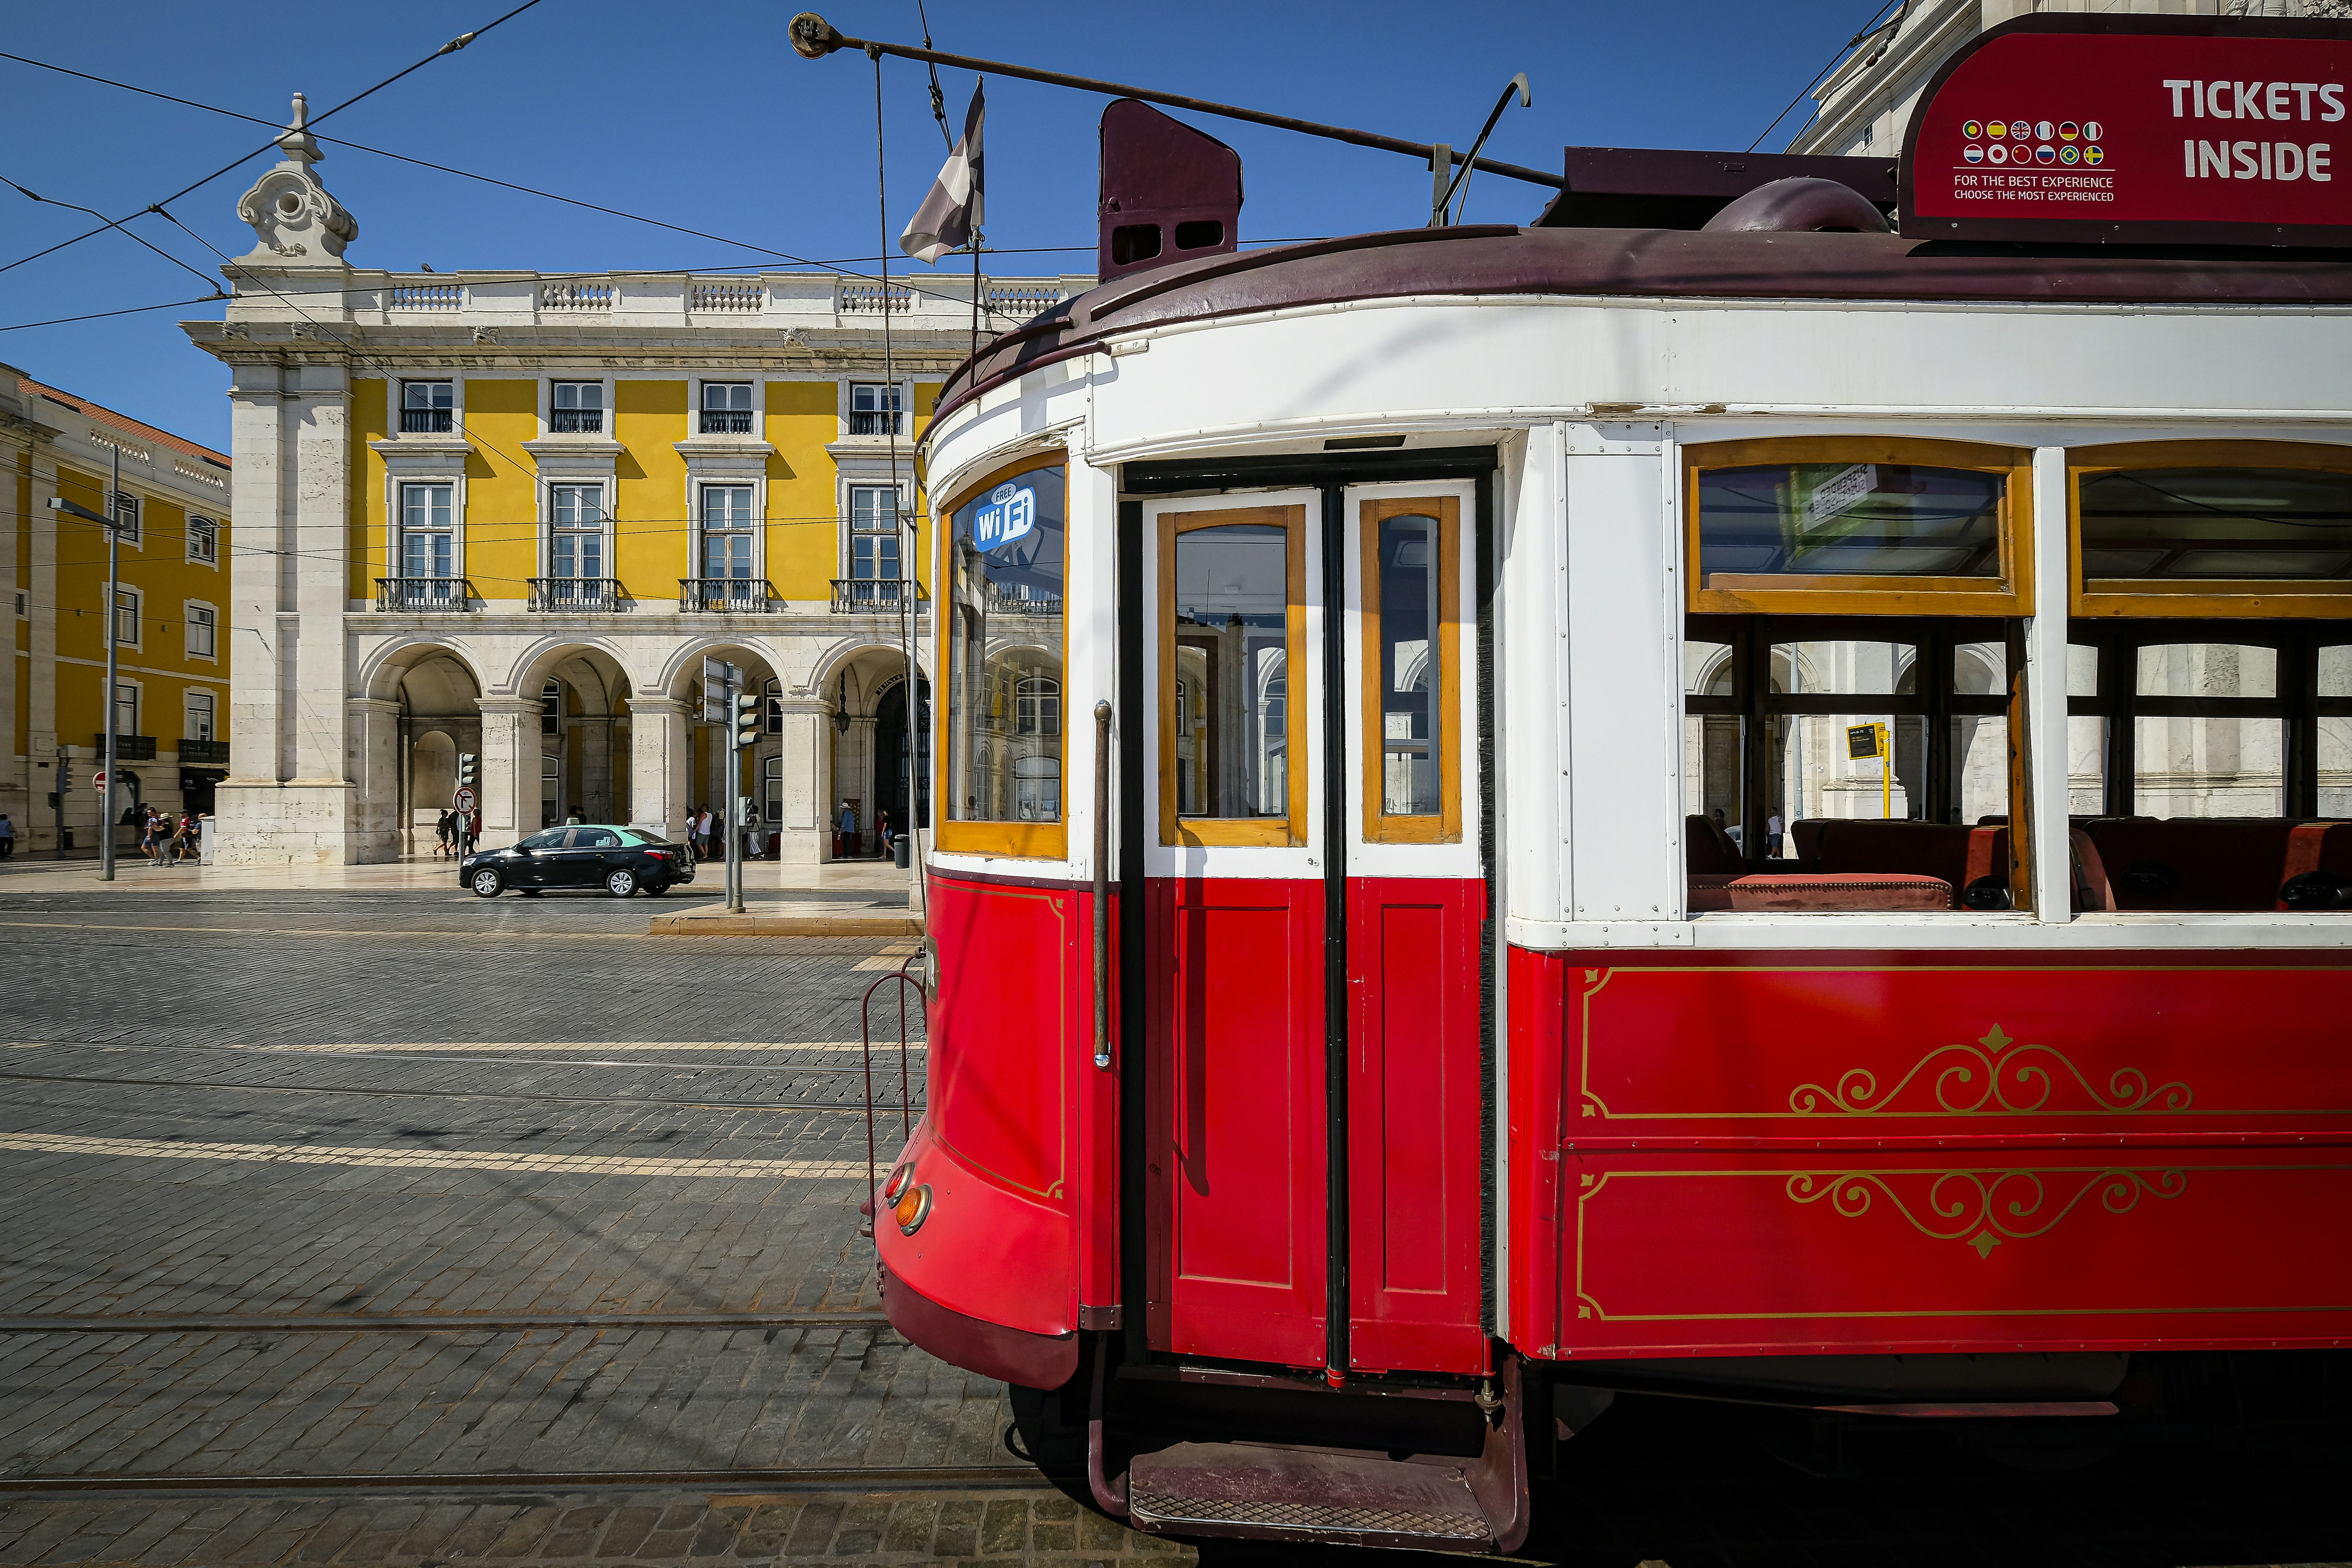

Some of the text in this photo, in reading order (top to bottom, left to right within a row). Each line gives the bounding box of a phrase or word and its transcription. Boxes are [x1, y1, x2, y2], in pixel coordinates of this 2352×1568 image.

[2163, 79, 2345, 122] TICKETS
[2184, 140, 2331, 182] INSIDE
[1955, 175, 2113, 188] FOR THE BEST EXPERIENCE
[1955, 190, 2114, 201] CHOOSE THE MOST EXPERIENCED
[996, 486, 1012, 503] FREE
